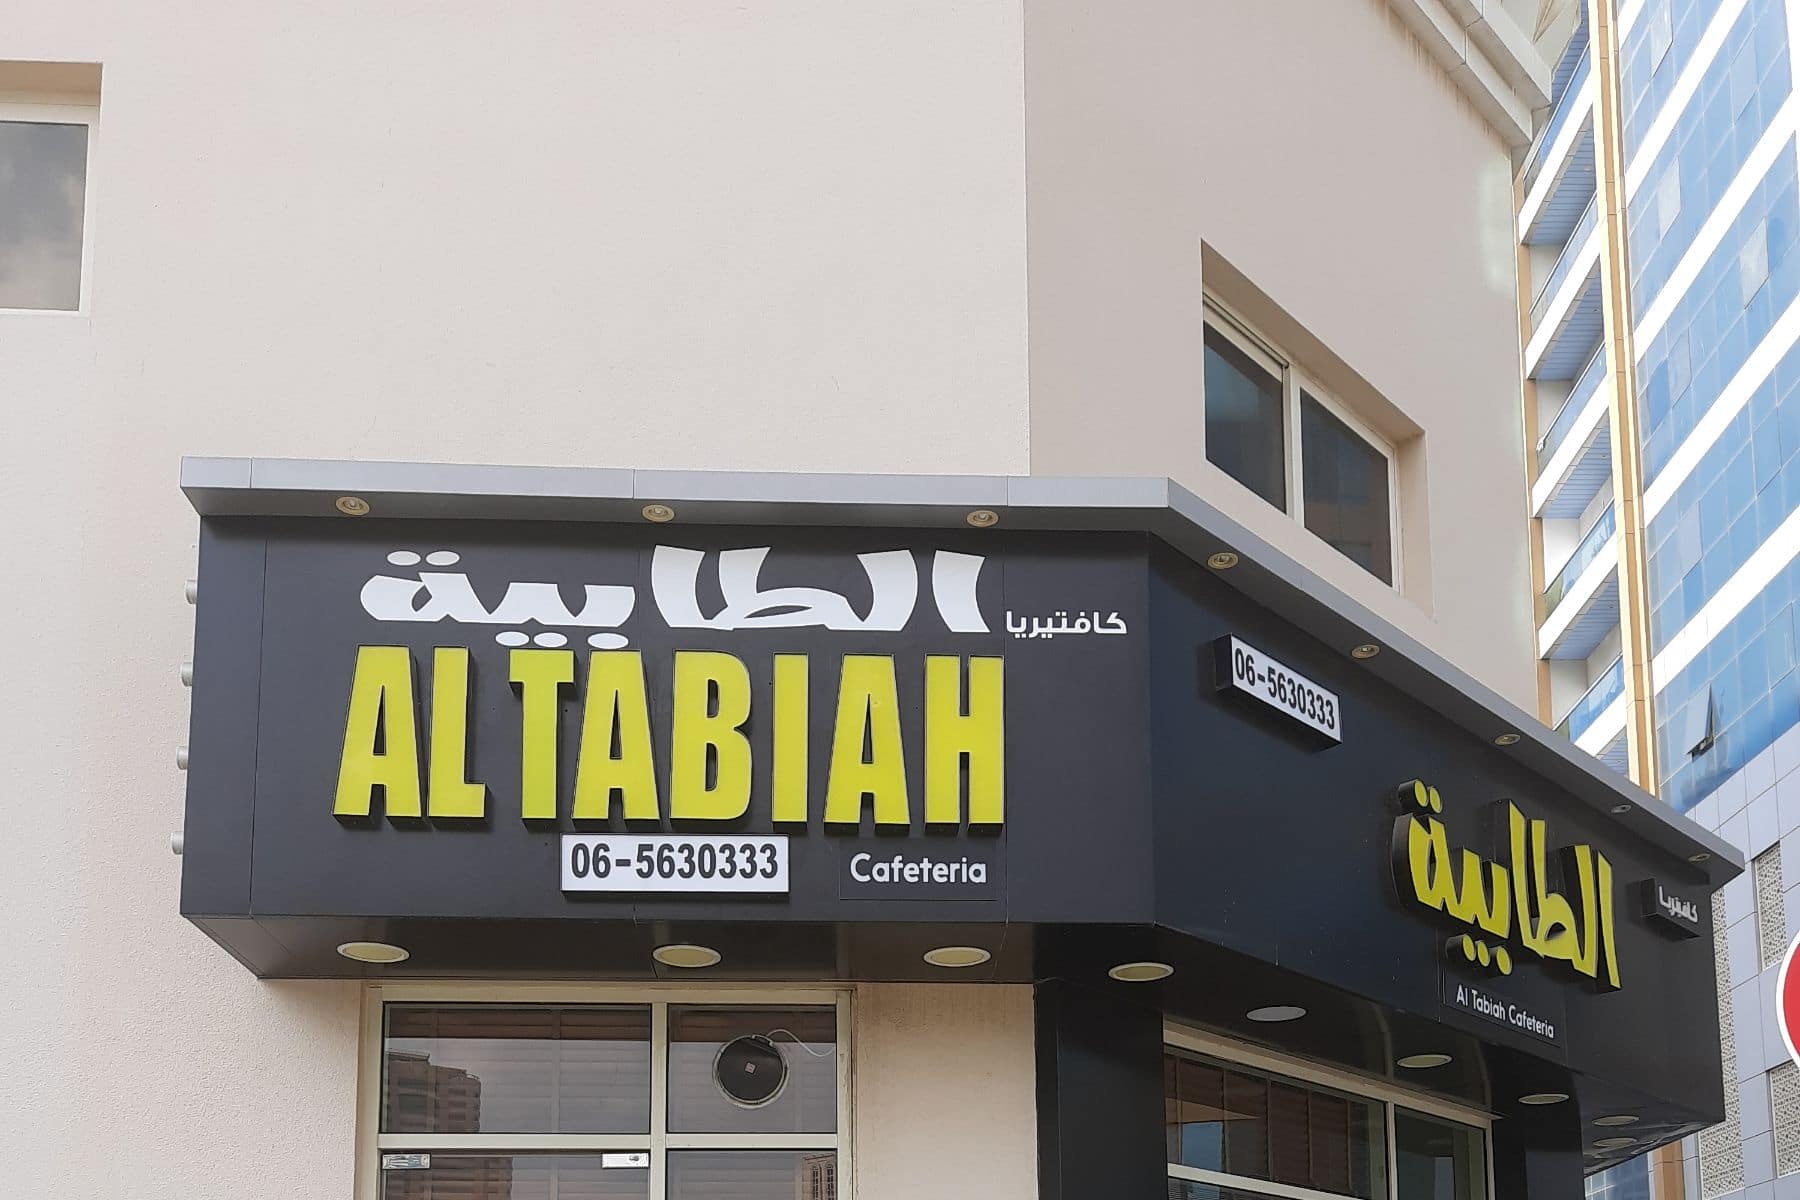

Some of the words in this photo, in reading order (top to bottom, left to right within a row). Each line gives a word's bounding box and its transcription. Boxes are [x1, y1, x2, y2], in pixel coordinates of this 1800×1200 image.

[360, 545, 991, 650] الطابية
[1005, 610, 1129, 639] كافتيريا
[1234, 647, 1336, 731] 06-5630333
[331, 644, 487, 819] AL
[508, 648, 1004, 826] TABIAH
[570, 843, 779, 880] 06-5630333
[849, 852, 988, 884] Cafeteria
[1407, 778, 1621, 990] الطابية
[1456, 983, 1469, 1007] Al
[1472, 988, 1506, 1021] Tabiah
[1508, 1004, 1555, 1039] Cafeteria
